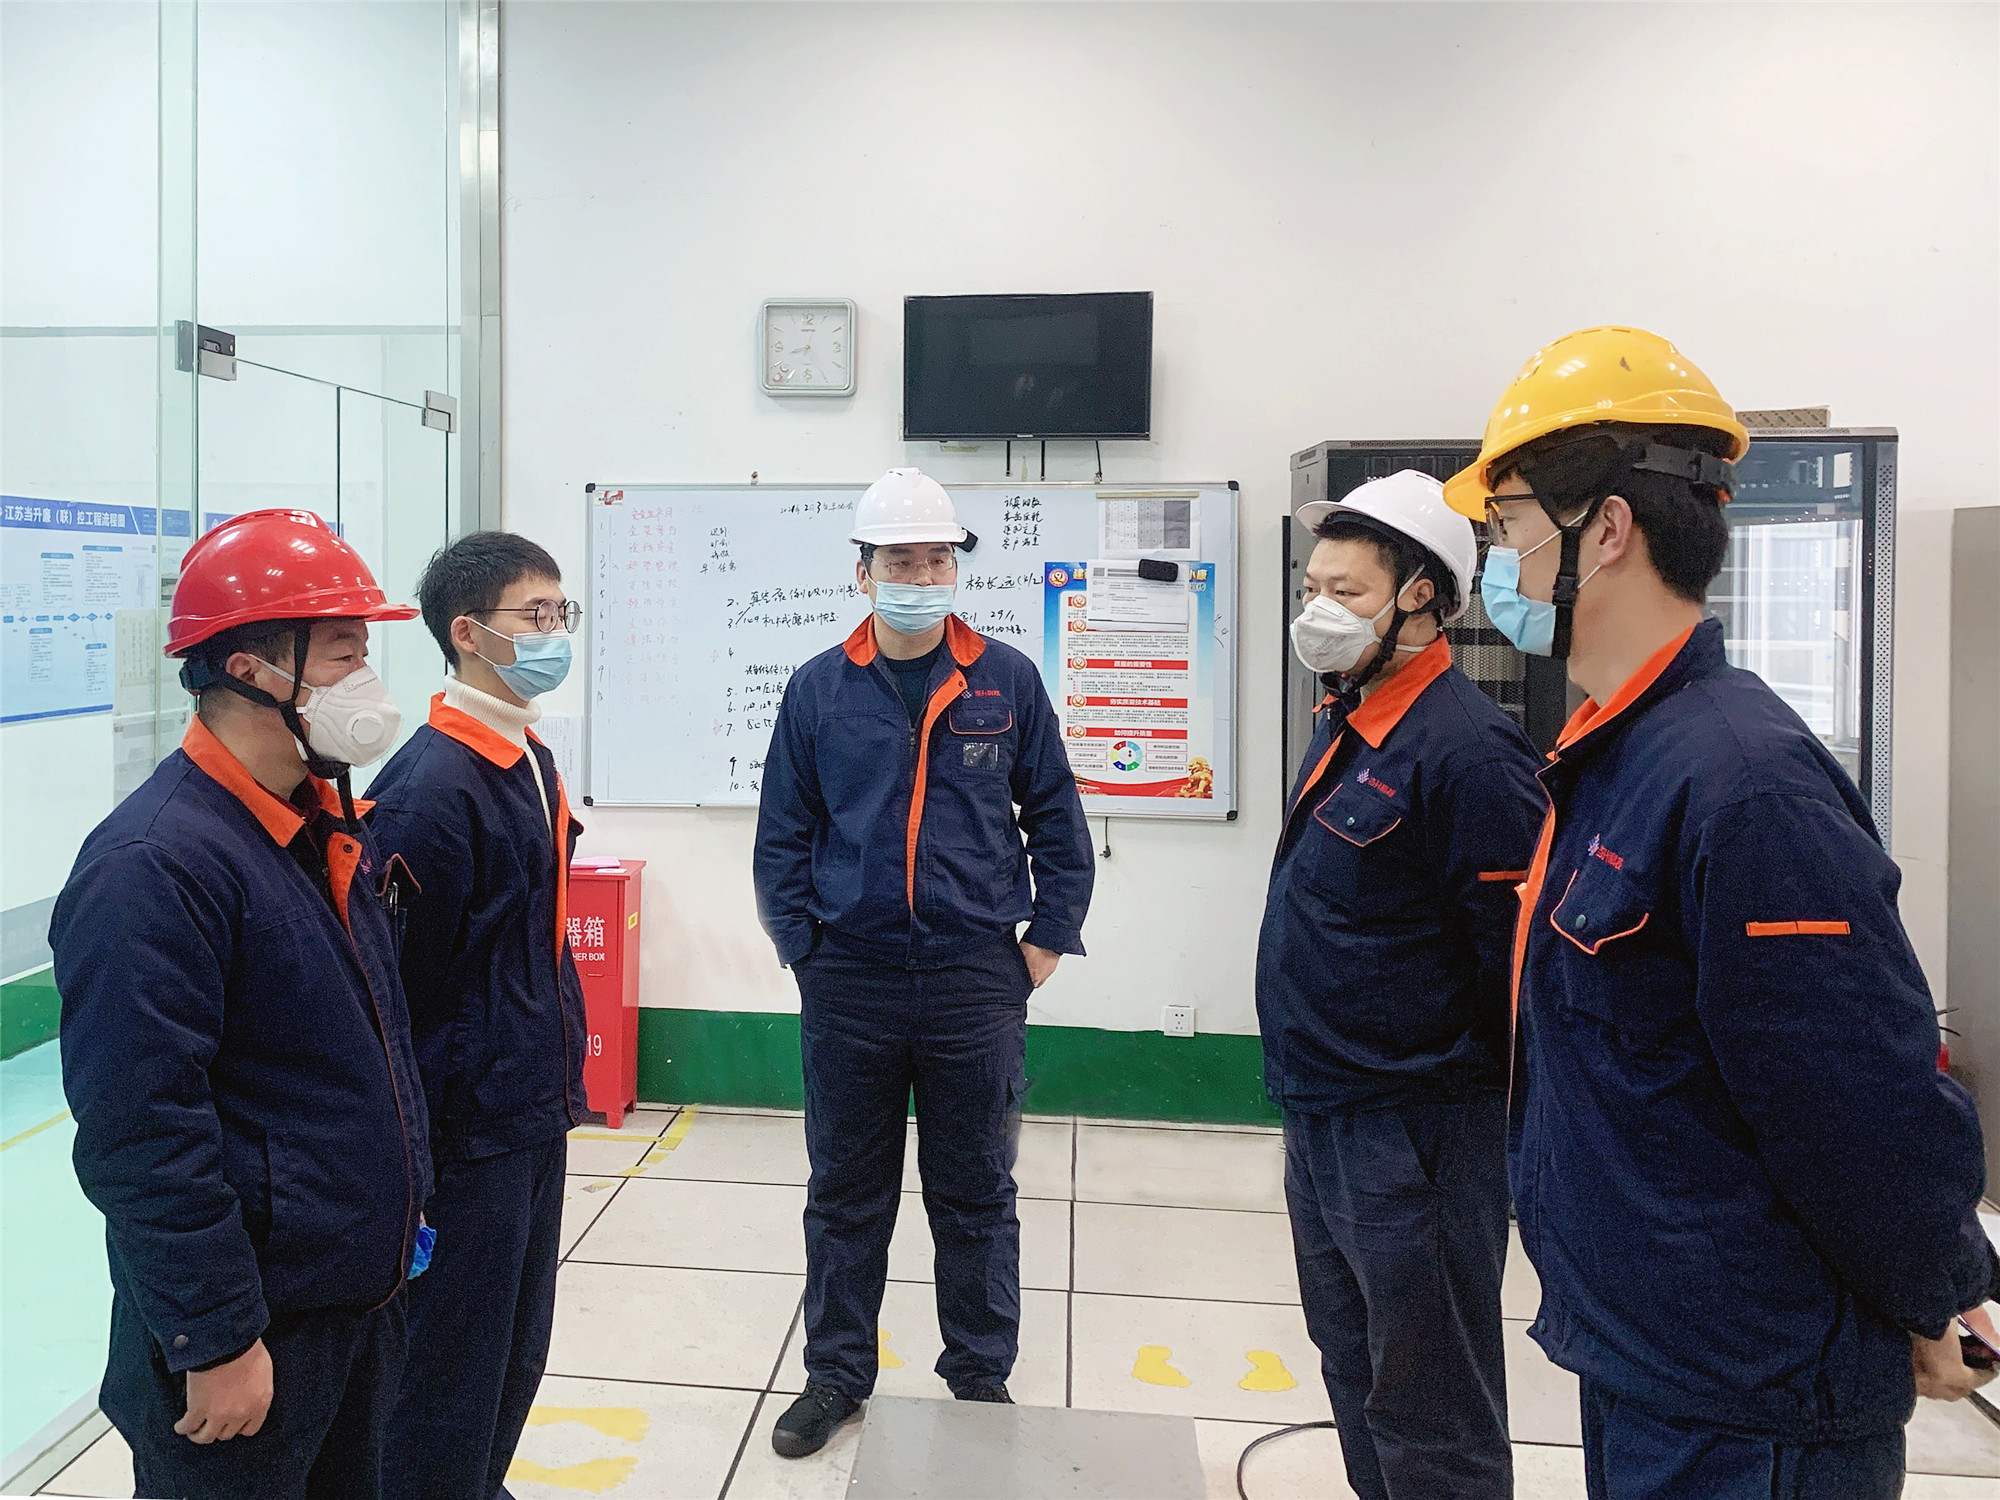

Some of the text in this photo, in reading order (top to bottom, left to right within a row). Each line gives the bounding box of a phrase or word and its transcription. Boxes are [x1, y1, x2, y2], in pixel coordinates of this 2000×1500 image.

[566, 916, 606, 947] 器箱
[588, 953, 605, 961] BOX
[586, 1033, 602, 1056] 19
